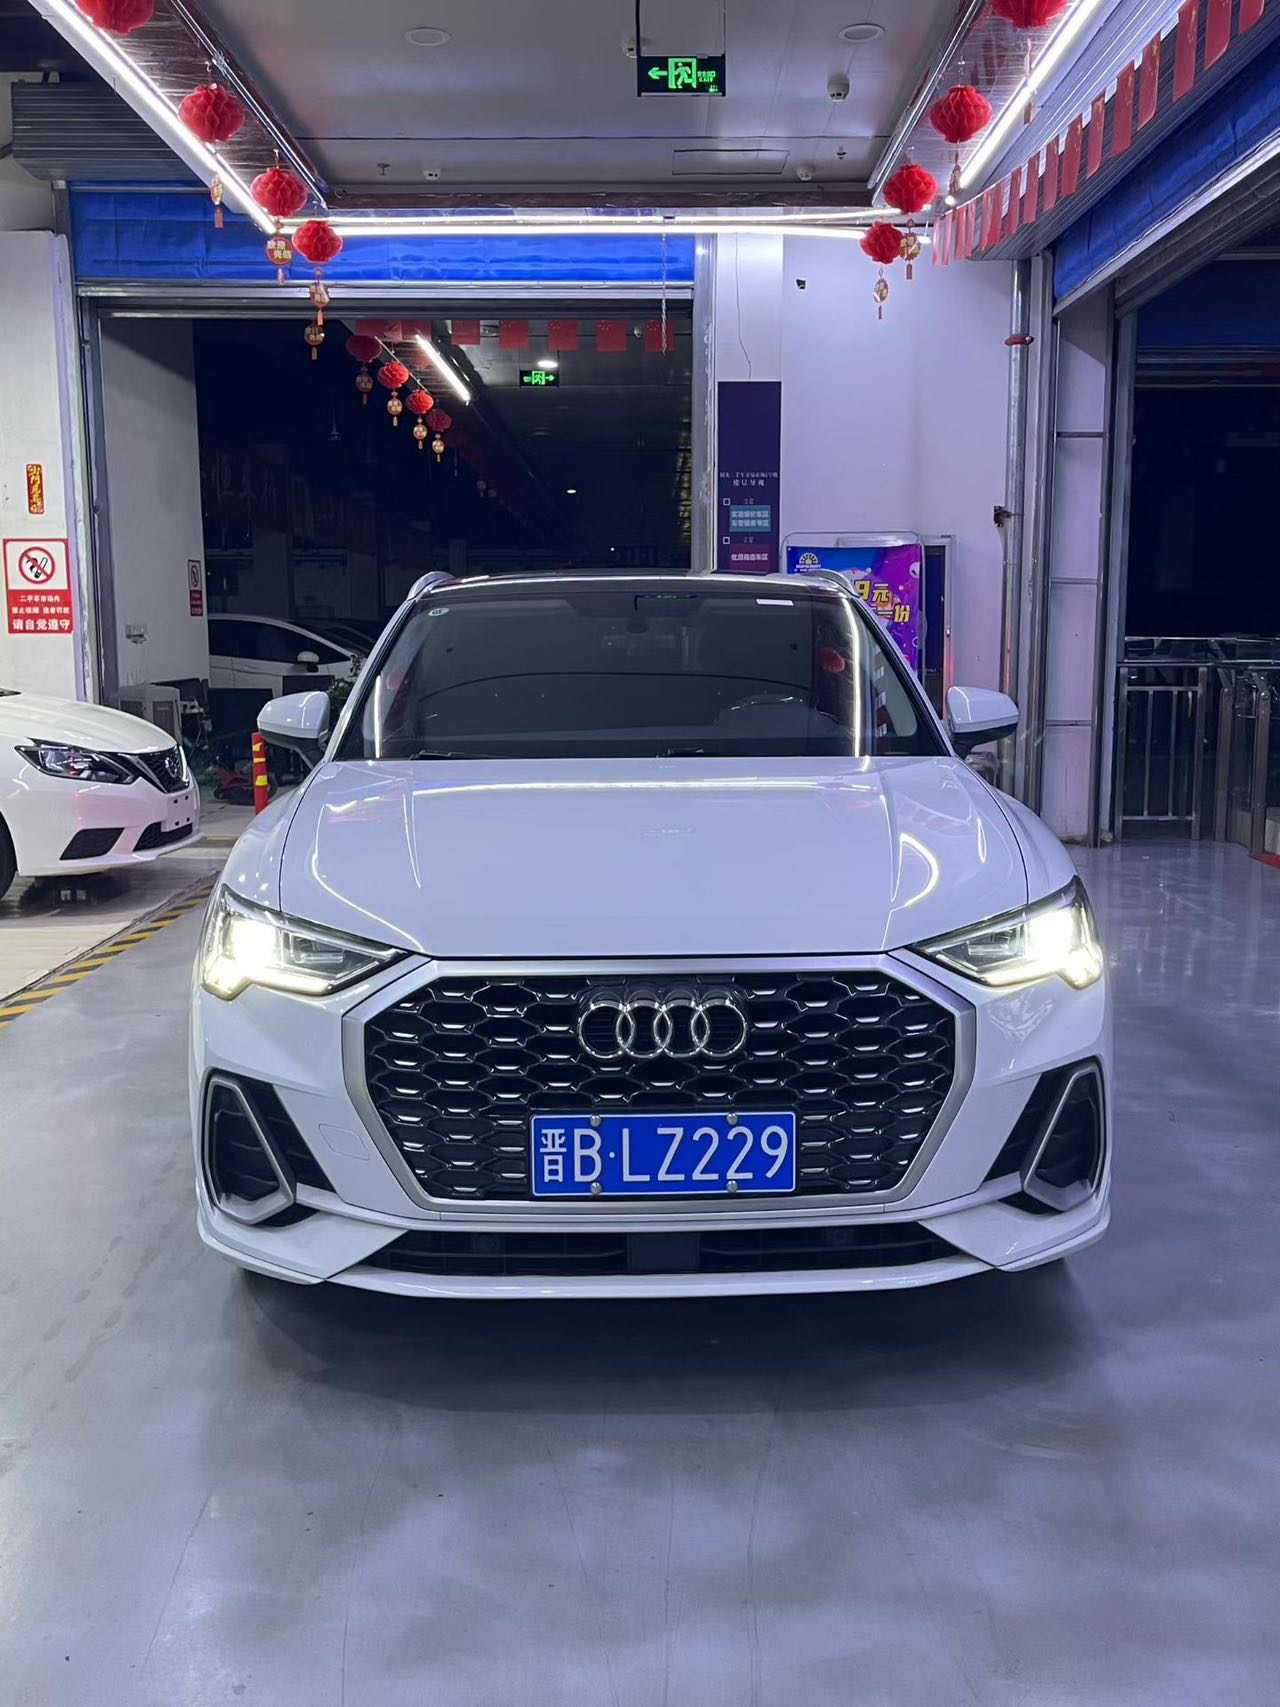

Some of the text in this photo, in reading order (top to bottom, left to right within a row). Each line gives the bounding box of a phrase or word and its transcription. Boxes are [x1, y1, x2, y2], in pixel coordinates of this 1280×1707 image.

[13, 618, 70, 631] 请自觉遵守
[539, 1125, 788, 1183] 晋B·LZ229
